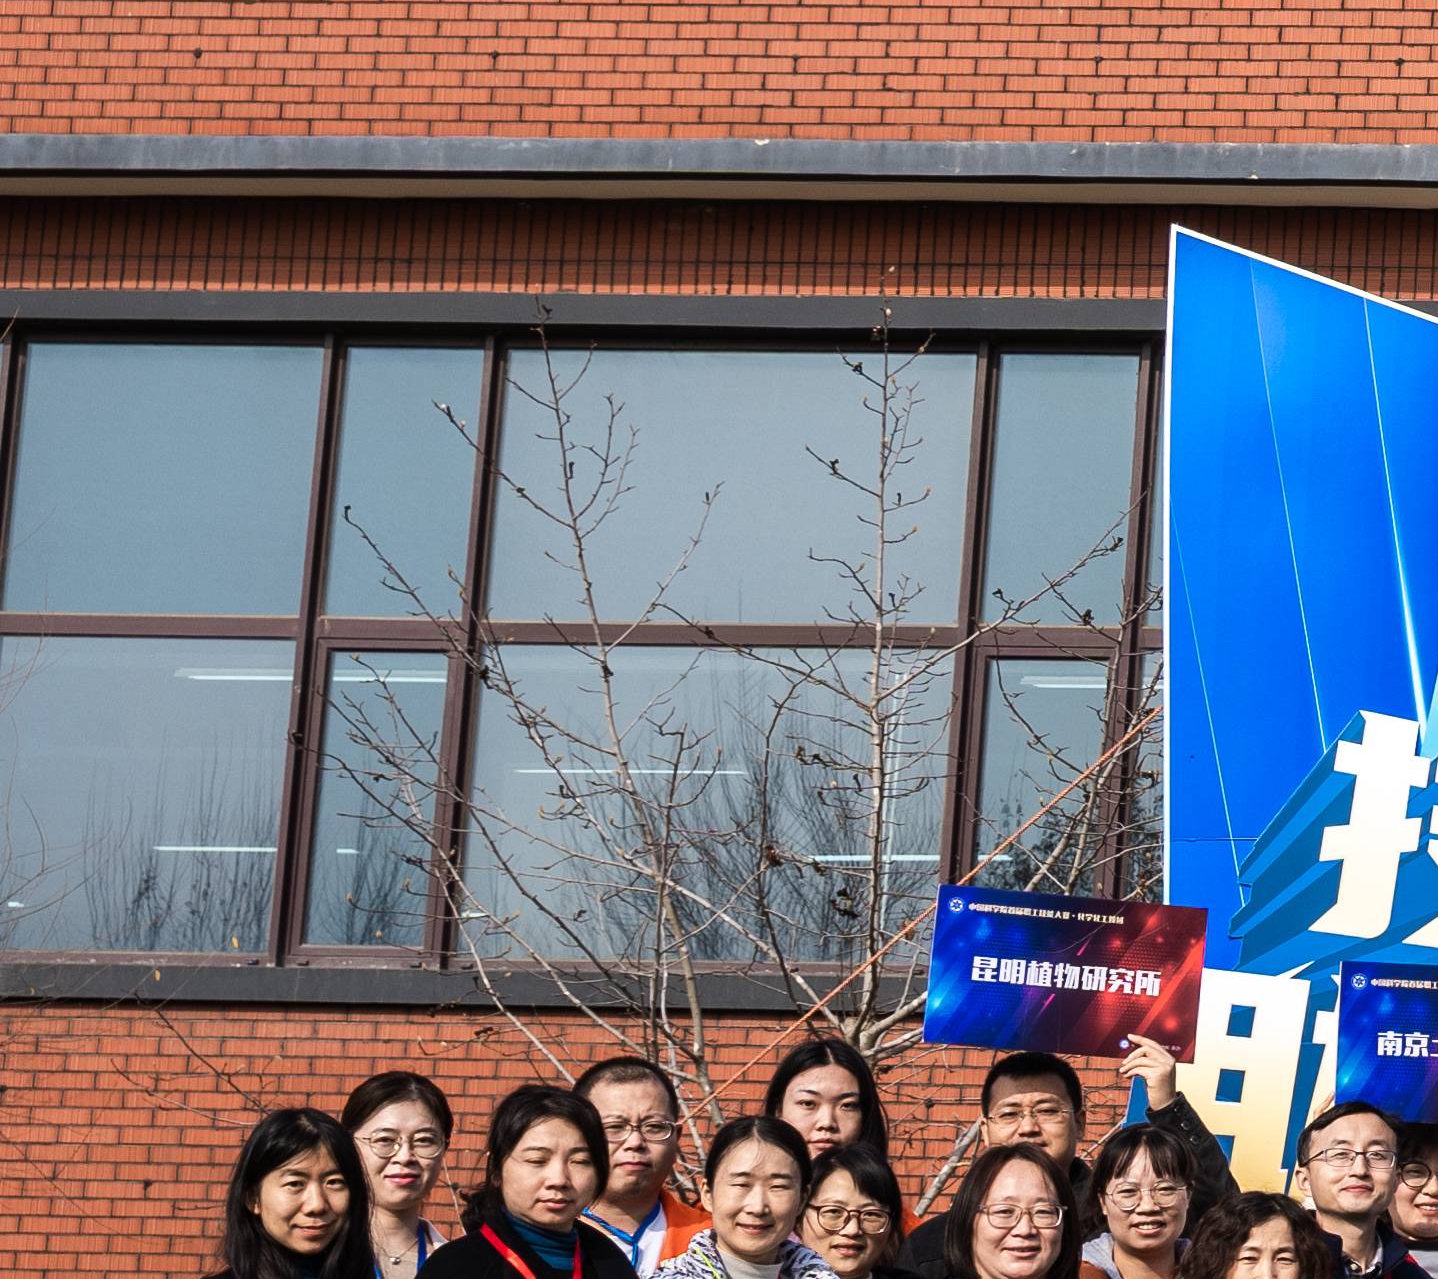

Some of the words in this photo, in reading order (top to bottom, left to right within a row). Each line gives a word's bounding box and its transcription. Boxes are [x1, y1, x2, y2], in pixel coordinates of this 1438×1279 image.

[971, 955, 1162, 998] 昆明植物研究所
